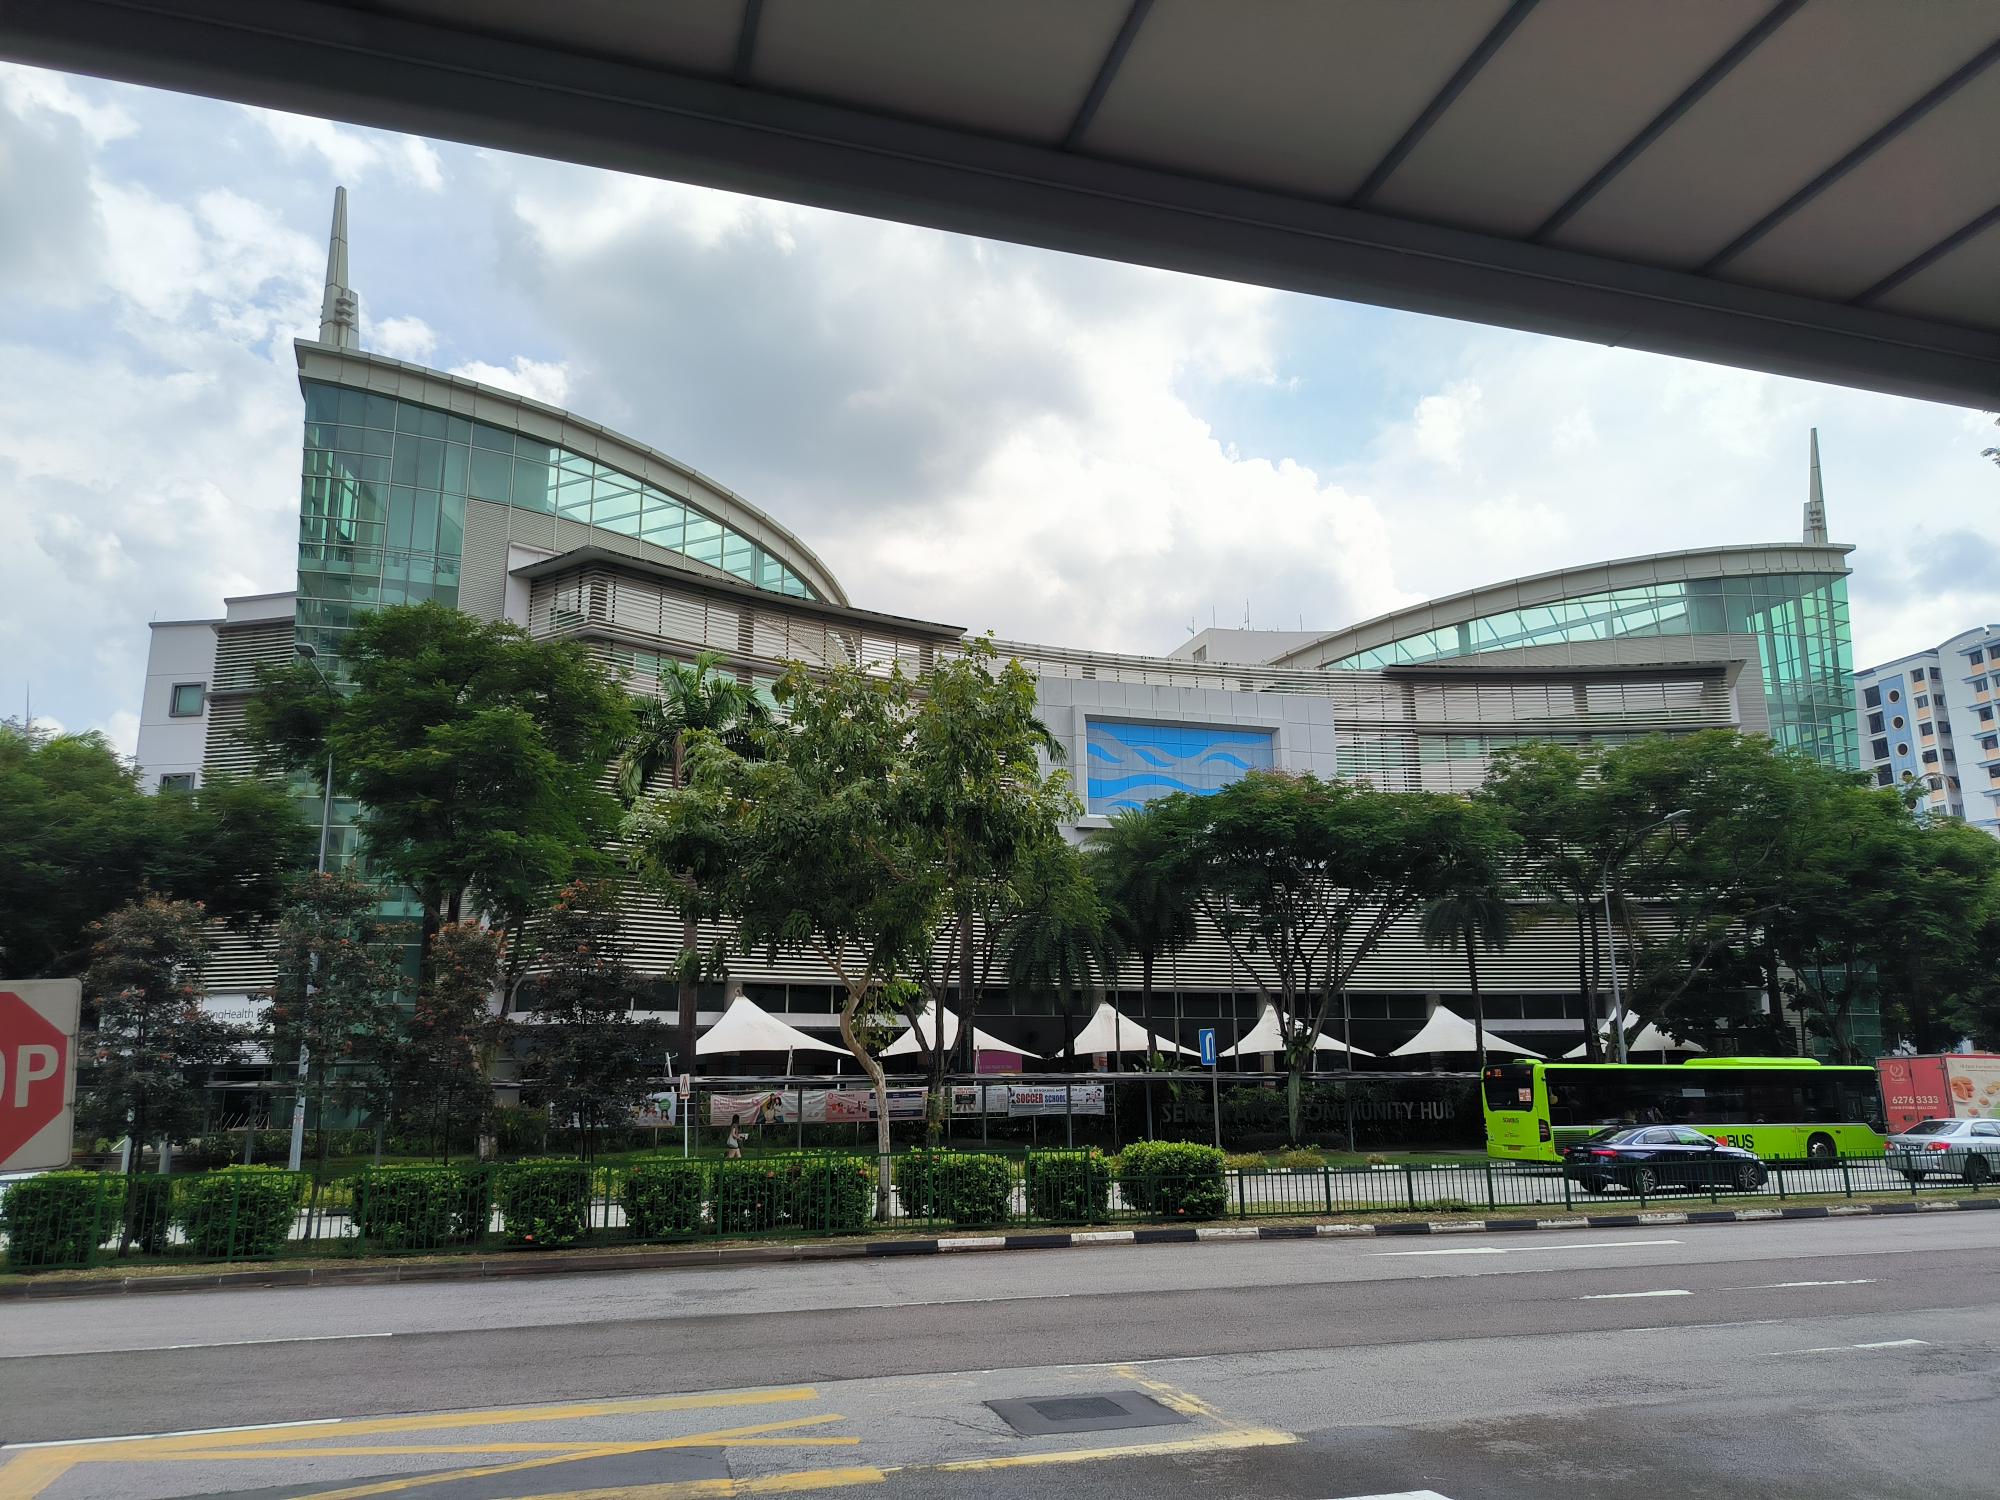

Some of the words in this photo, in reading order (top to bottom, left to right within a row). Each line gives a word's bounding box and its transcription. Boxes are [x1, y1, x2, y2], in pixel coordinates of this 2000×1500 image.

[1016, 1093, 1043, 1104] SOCCER
[1892, 1096, 1914, 1104] 6276
[1916, 1095, 1939, 1104] 3333
[1420, 1101, 1455, 1120] HUB
[1727, 1134, 1755, 1149] BUS
